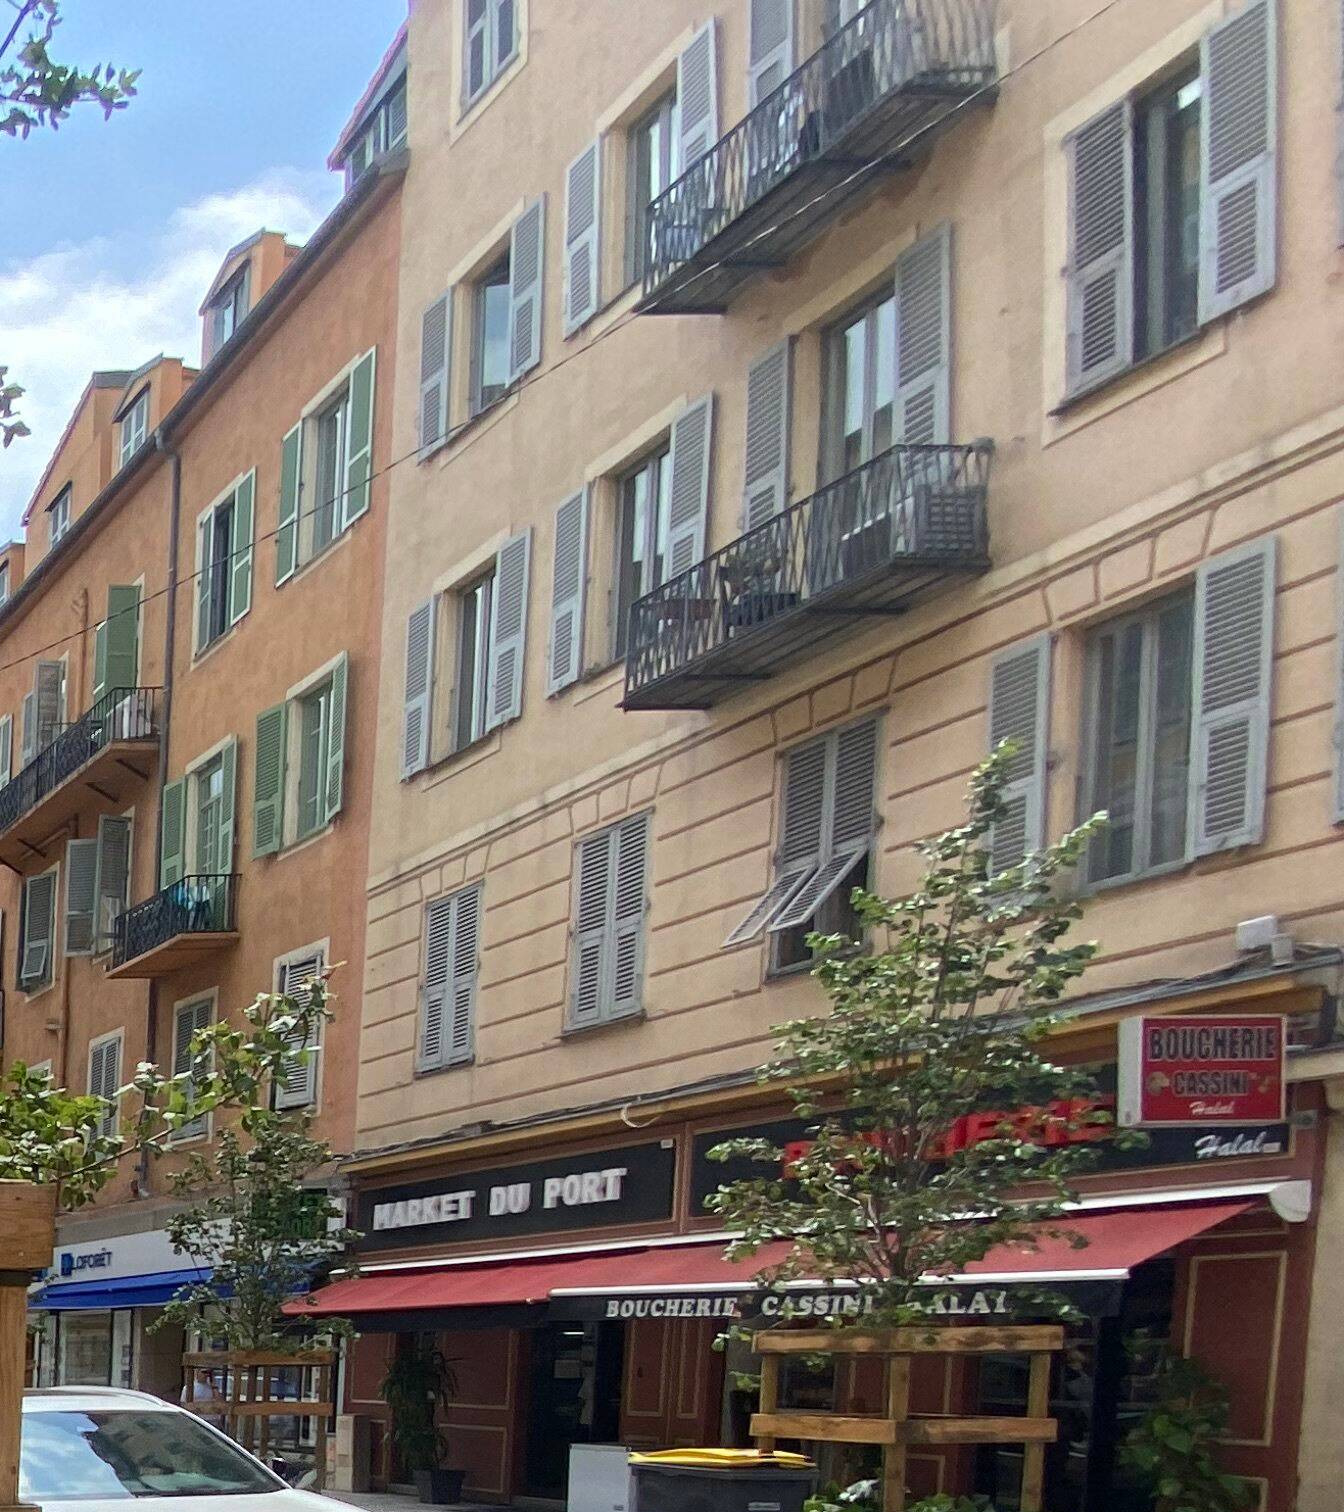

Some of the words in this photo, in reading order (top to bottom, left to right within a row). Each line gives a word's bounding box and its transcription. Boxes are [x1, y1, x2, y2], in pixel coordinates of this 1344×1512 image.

[1147, 1026, 1277, 1061] BOUCHERIE
[1172, 1069, 1250, 1097] CASSINI
[1187, 1100, 1235, 1116] Halal
[1193, 1130, 1268, 1159] Halal
[372, 1190, 476, 1231] MARKET
[488, 1182, 531, 1216] DU
[542, 1167, 628, 1209] PORT
[605, 1296, 740, 1318] BOUCHERIE
[760, 1294, 874, 1316] CASSINI
